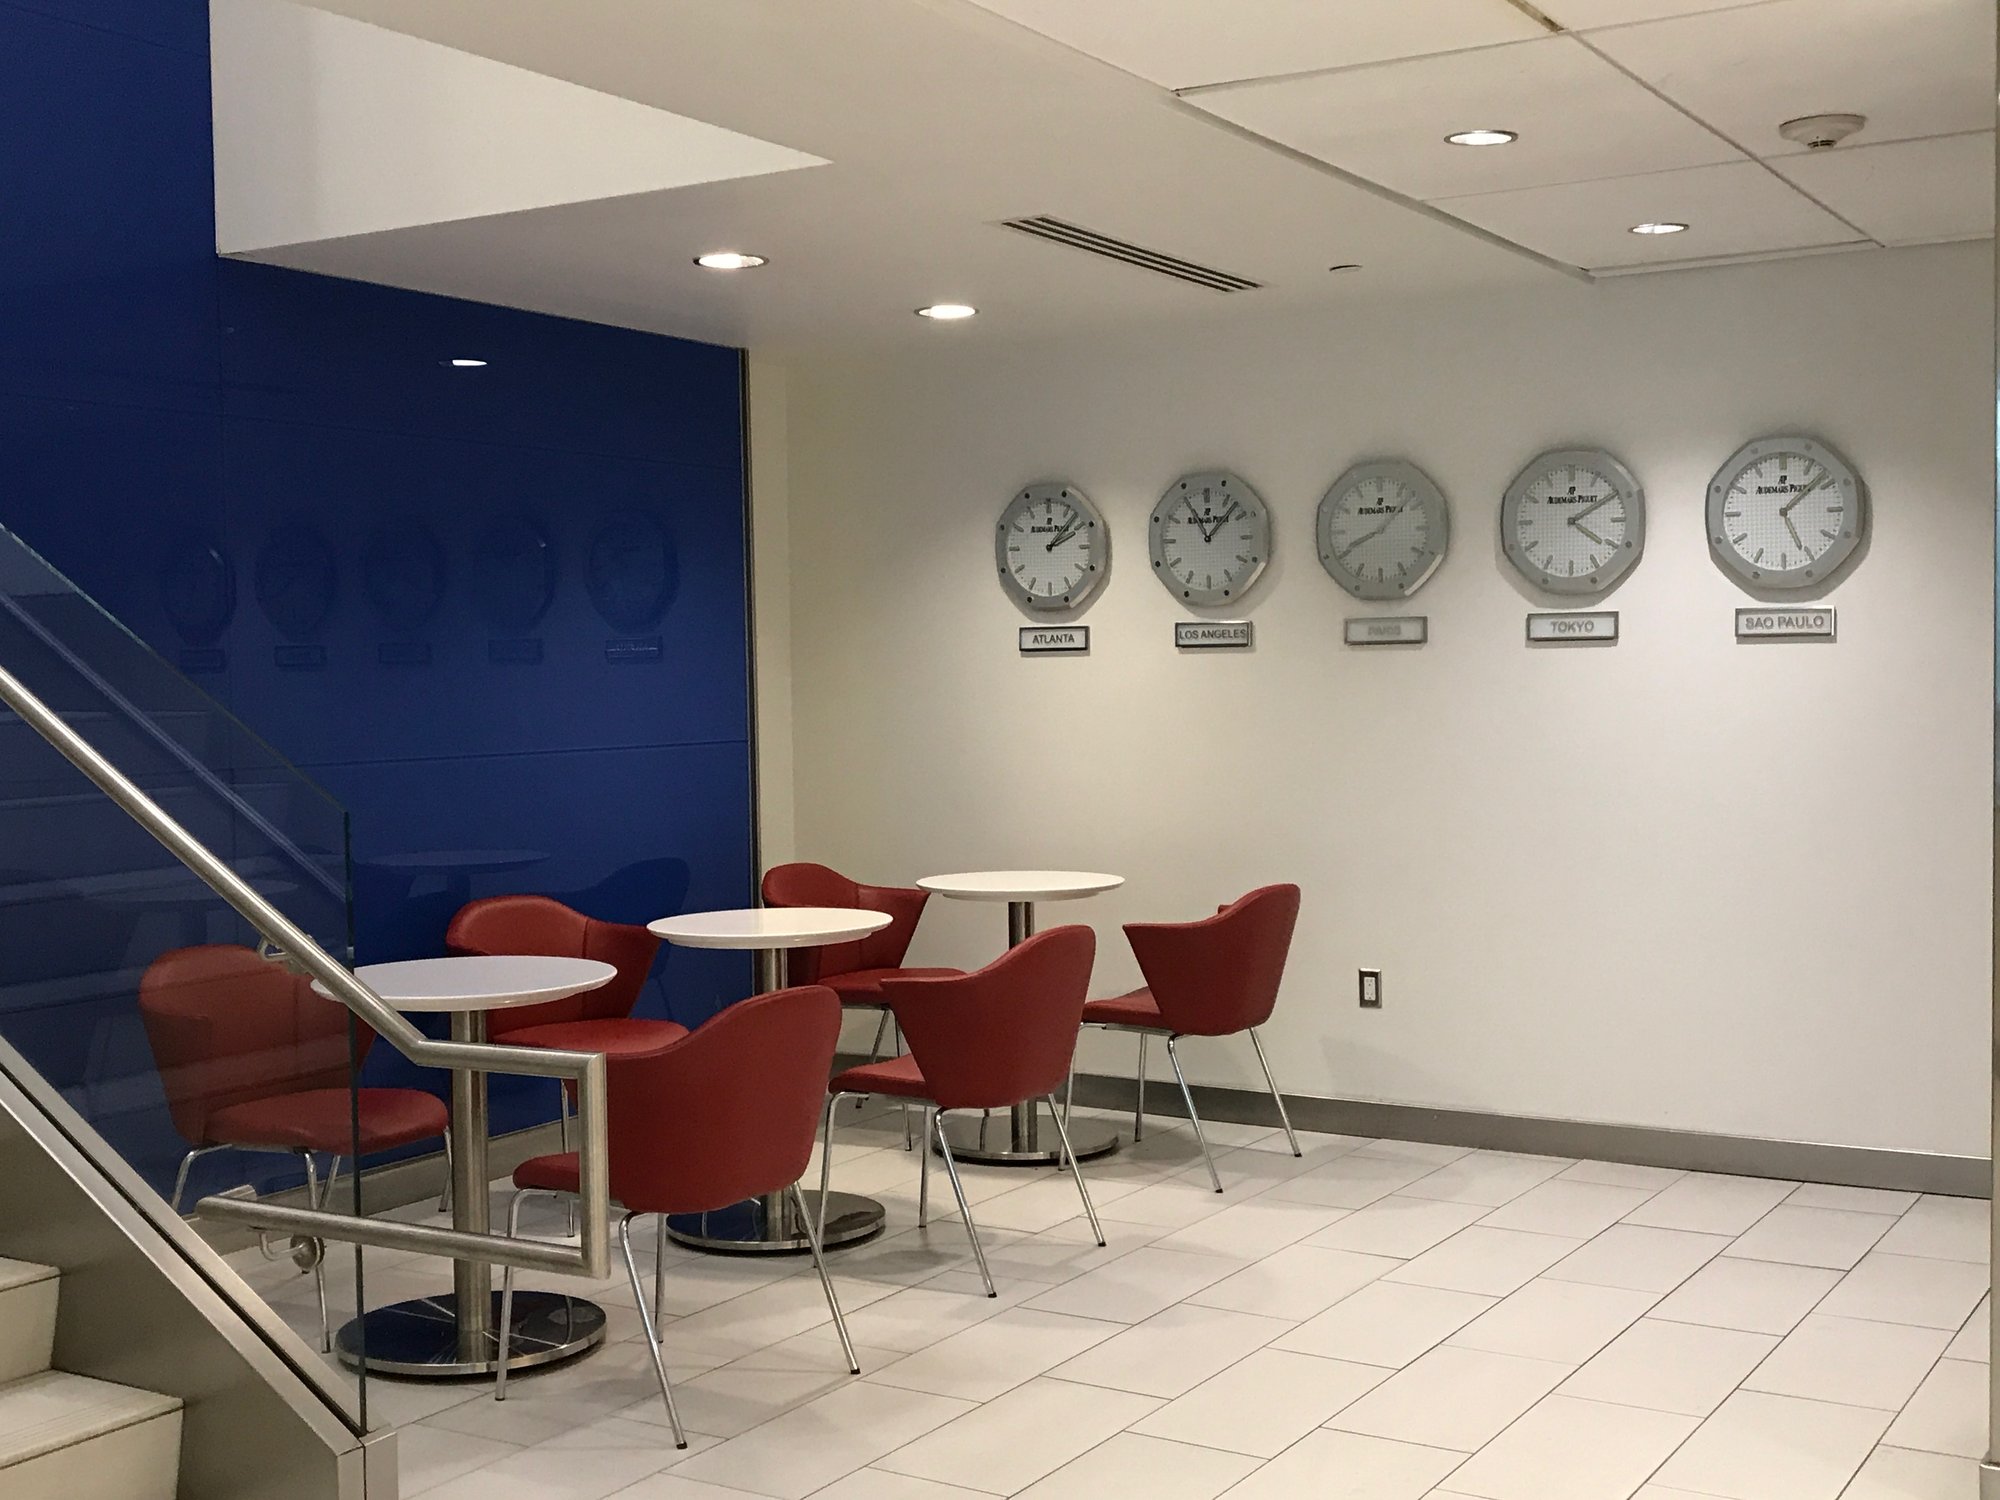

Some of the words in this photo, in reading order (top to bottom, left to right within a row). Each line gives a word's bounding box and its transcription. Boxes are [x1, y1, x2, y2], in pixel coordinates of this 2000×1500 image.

[1756, 486, 1789, 494] AUDEMARS
[1547, 496, 1577, 504] AUDEMARS
[1577, 495, 1598, 503] PIGUET
[1550, 620, 1595, 633] TOKYO
[1745, 617, 1774, 630] SAO
[1777, 615, 1824, 628] PAULO
[1032, 633, 1075, 644] ATLANTA
[1179, 630, 1200, 640] LOS
[1200, 629, 1247, 639] ANGELES
